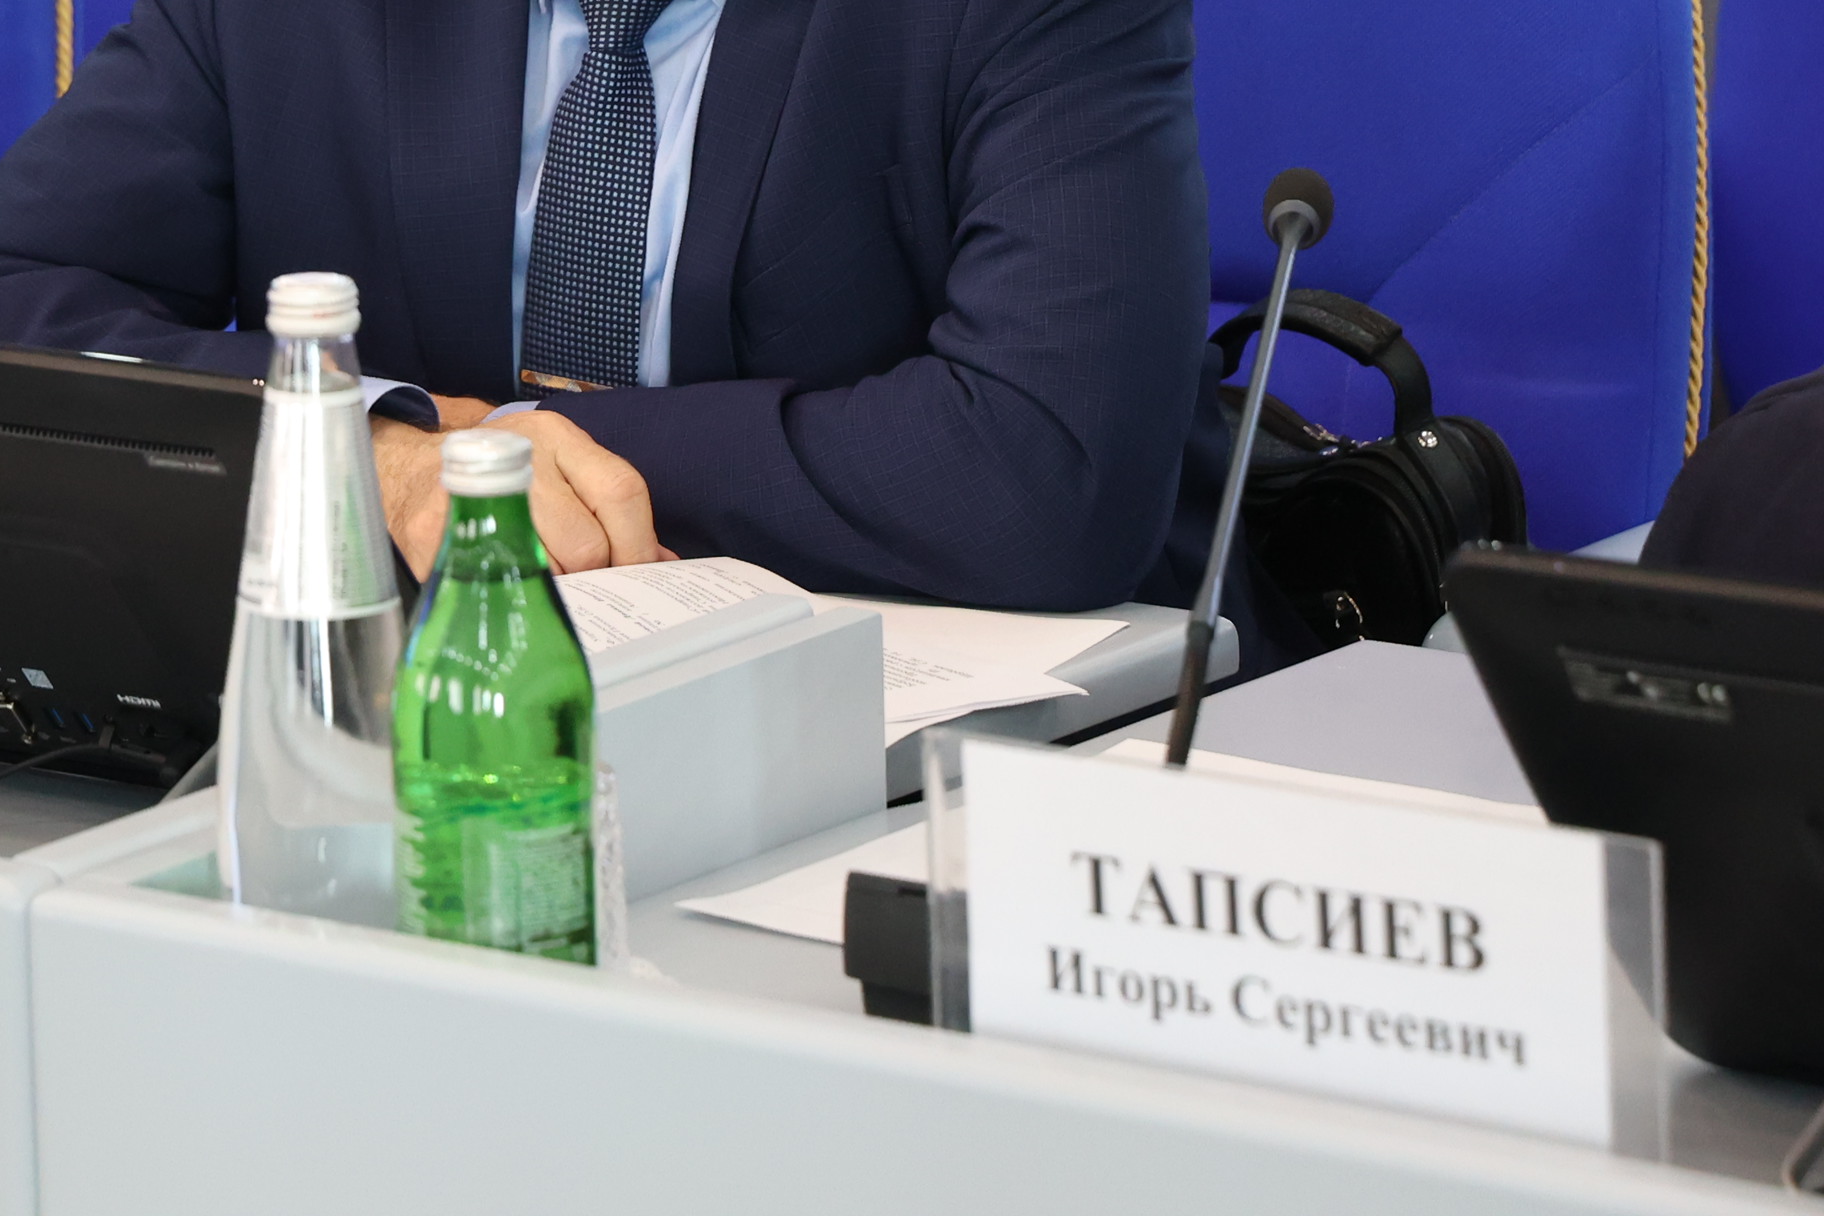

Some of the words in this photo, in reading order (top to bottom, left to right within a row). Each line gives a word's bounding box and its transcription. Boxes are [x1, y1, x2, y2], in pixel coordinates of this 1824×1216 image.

[1071, 850, 1488, 974] ТАПСИЕВ
[1046, 946, 1212, 1023] Игорь
[1230, 974, 1528, 1068] Сергеевич
